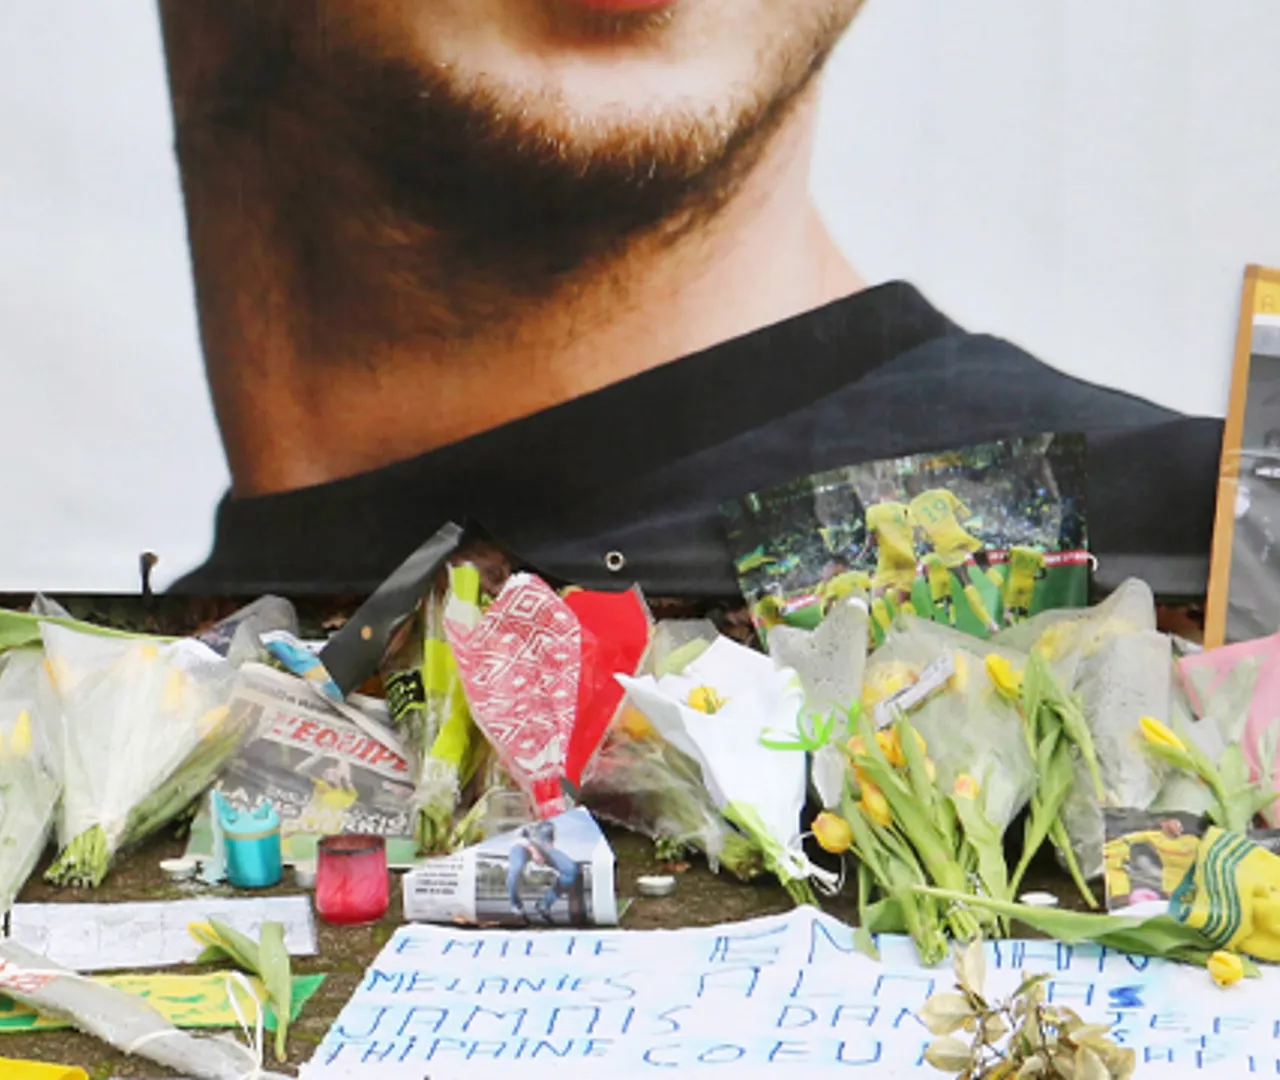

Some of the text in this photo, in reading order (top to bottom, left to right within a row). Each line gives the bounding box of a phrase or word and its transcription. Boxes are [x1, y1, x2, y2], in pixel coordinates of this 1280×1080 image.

[394, 935, 622, 958] EMILIE
[336, 1003, 930, 1041] JAMAIS DAN
